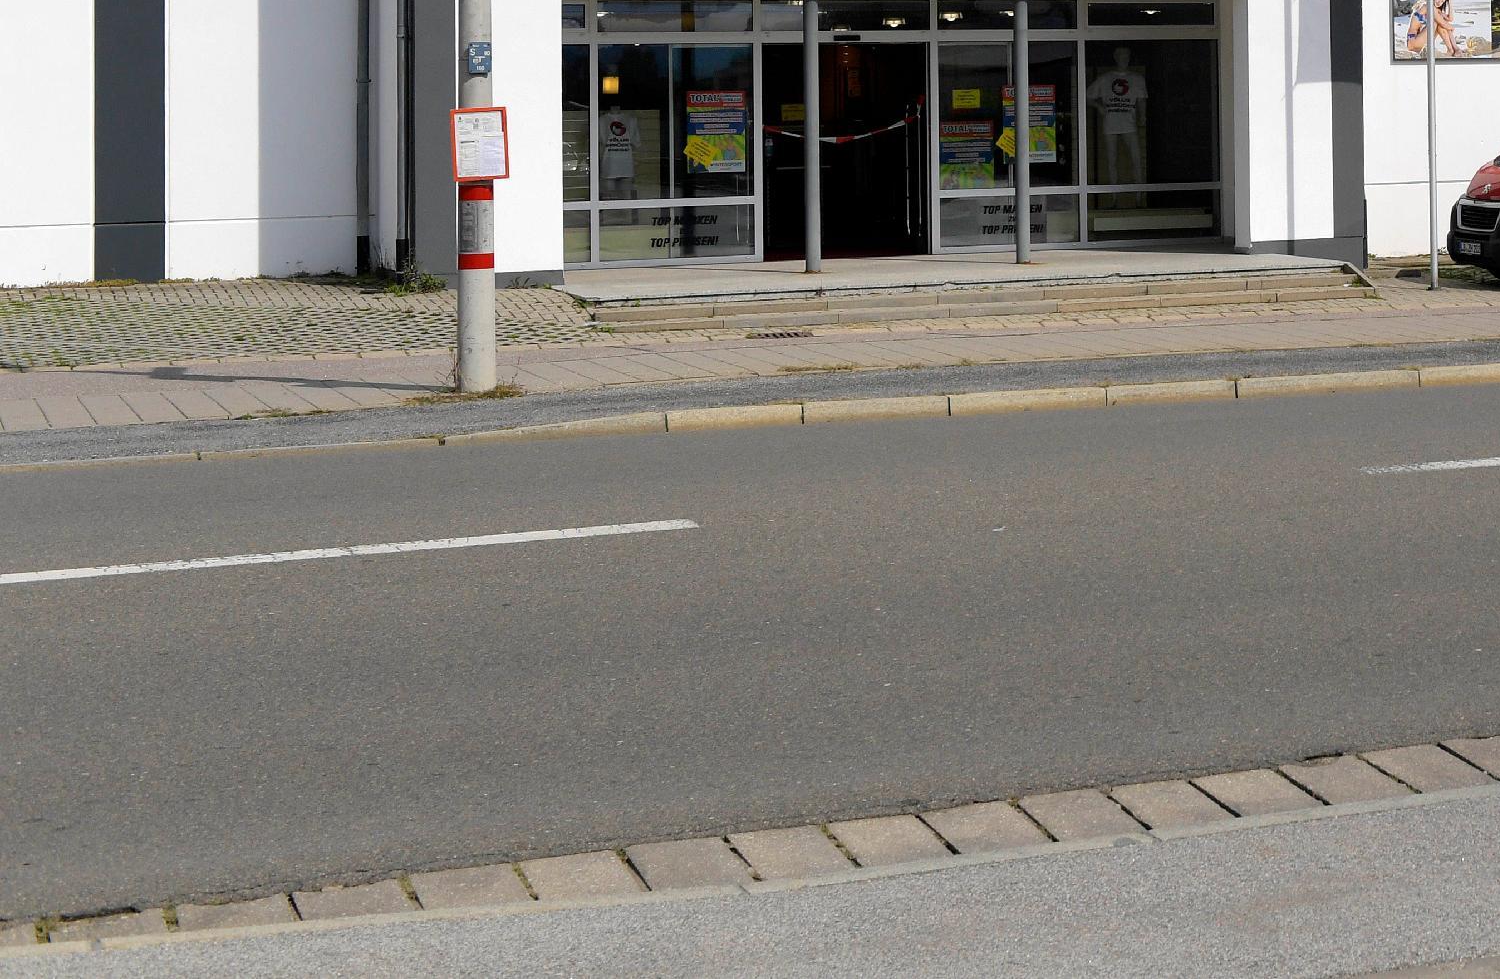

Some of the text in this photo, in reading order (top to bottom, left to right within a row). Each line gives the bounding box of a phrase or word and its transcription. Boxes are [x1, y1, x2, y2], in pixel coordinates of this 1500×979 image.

[983, 206, 1001, 214] TOP
[651, 217, 671, 226] TOP
[982, 225, 1000, 235] TOP
[650, 238, 670, 248] TOP
